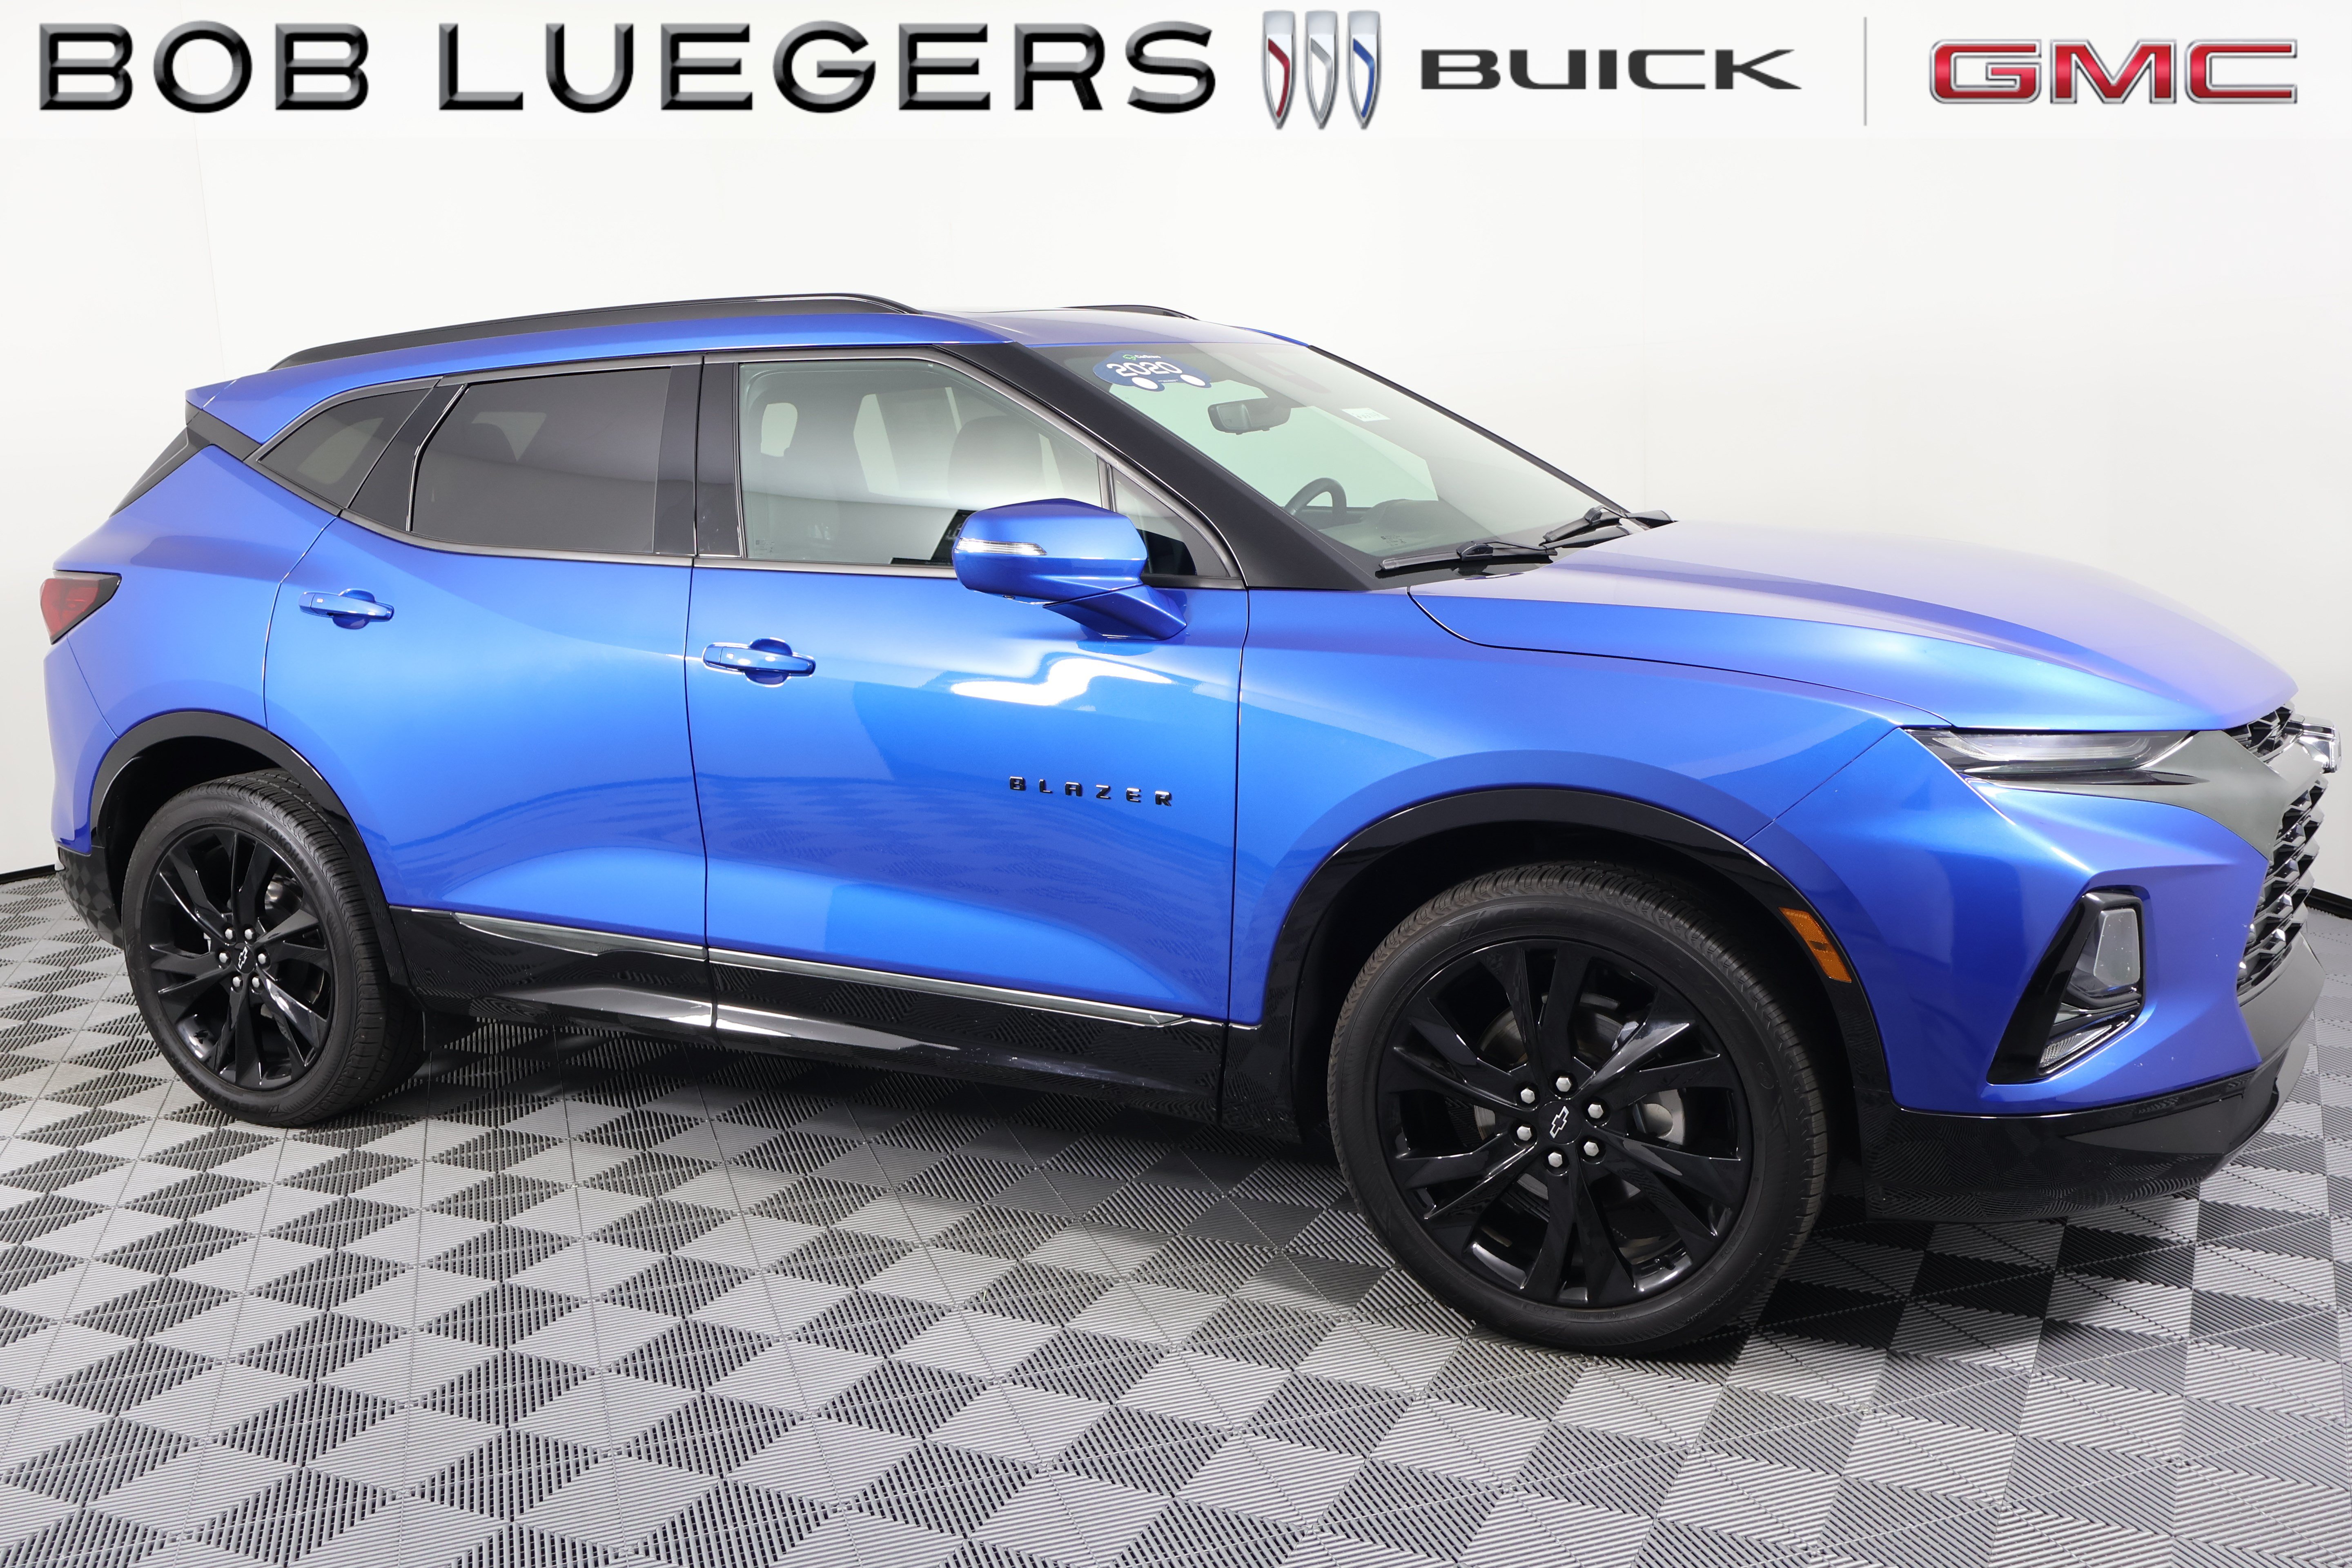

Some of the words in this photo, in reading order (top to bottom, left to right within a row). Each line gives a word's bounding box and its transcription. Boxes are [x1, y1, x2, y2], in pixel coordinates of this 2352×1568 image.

[1106, 361, 1183, 377] 2020
[1009, 776, 1172, 806] BLAZER
[266, 823, 318, 889] YOKOHAMA
